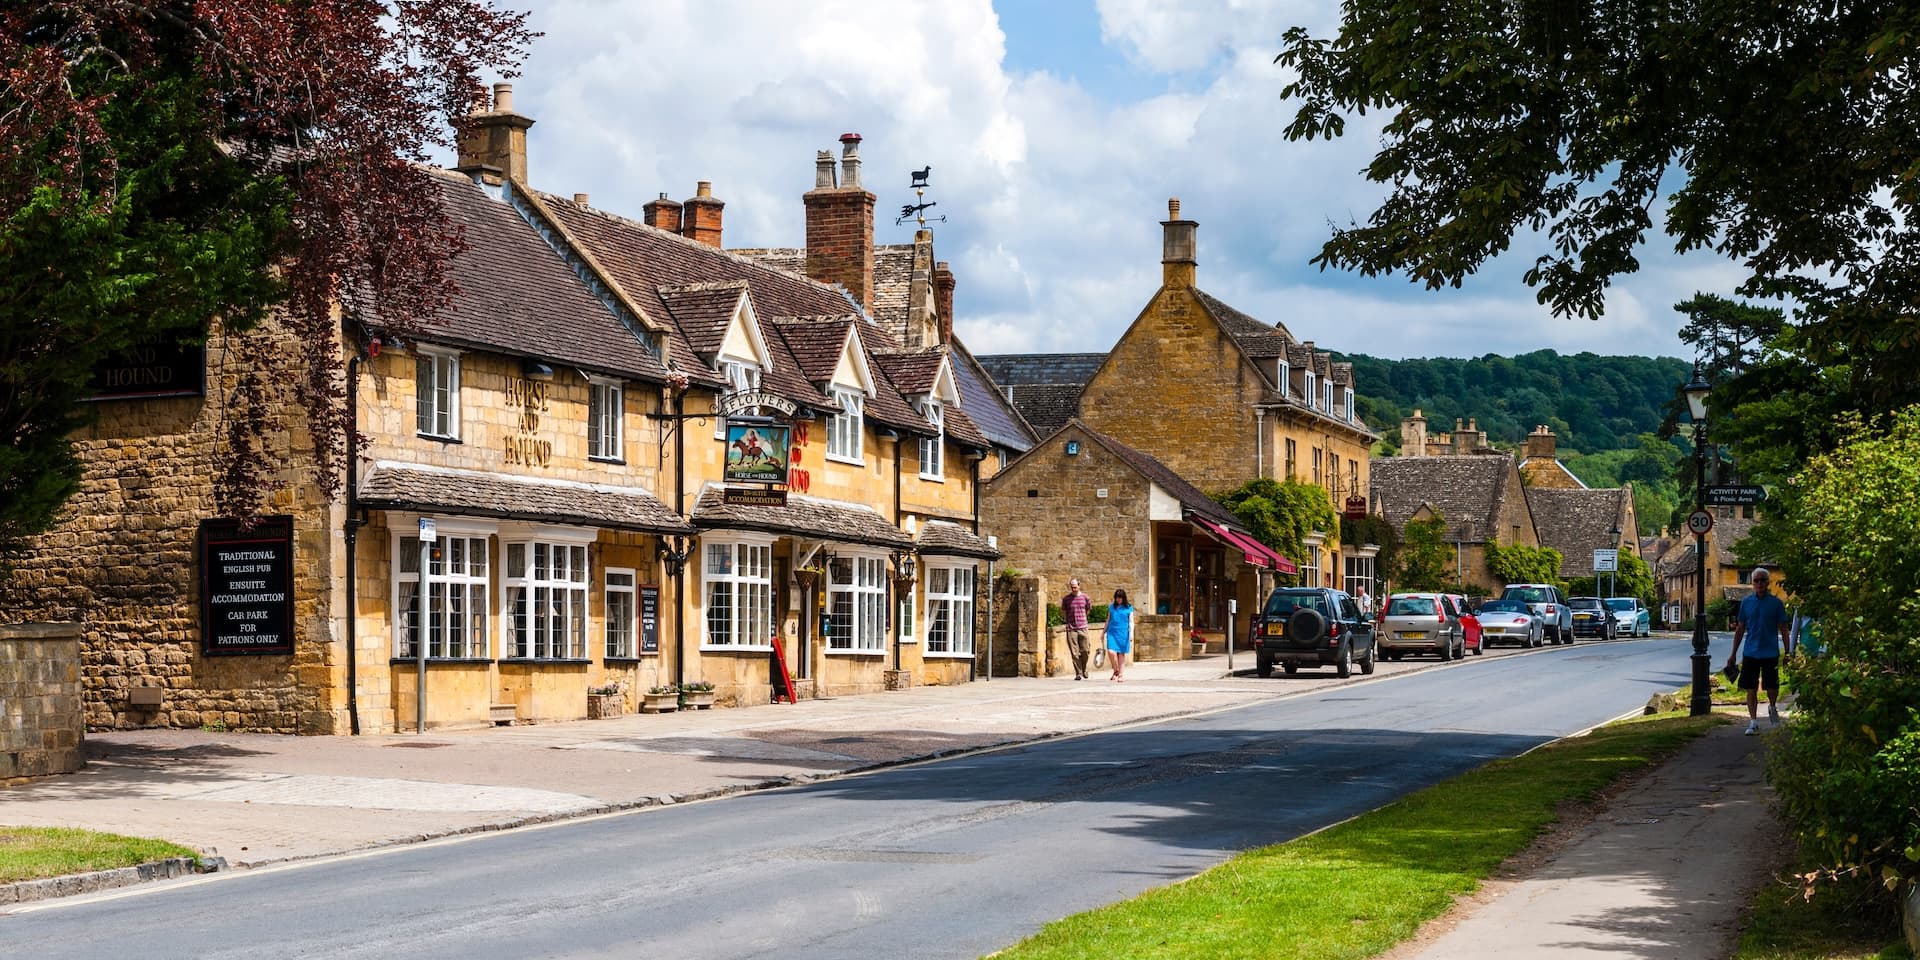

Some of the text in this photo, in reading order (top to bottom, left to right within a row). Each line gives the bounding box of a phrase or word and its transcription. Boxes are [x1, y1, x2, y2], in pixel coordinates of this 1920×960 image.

[105, 366, 173, 387] HOUND
[504, 376, 550, 411] HORSE
[729, 394, 794, 412] FLOWERS
[518, 413, 540, 436] AND
[503, 435, 552, 469] HOUND
[728, 495, 783, 505] ACCOMMODATION
[1692, 516, 1709, 527] 30
[218, 551, 276, 560] TRADITIONAL
[223, 564, 271, 574] ENGLISH PUB
[229, 580, 266, 590] ENSUITE
[211, 593, 285, 604] ACCOMMODATION
[228, 610, 268, 620] CAR PARK
[240, 623, 257, 632] FOR
[218, 634, 279, 645] PATRONS ONLY
